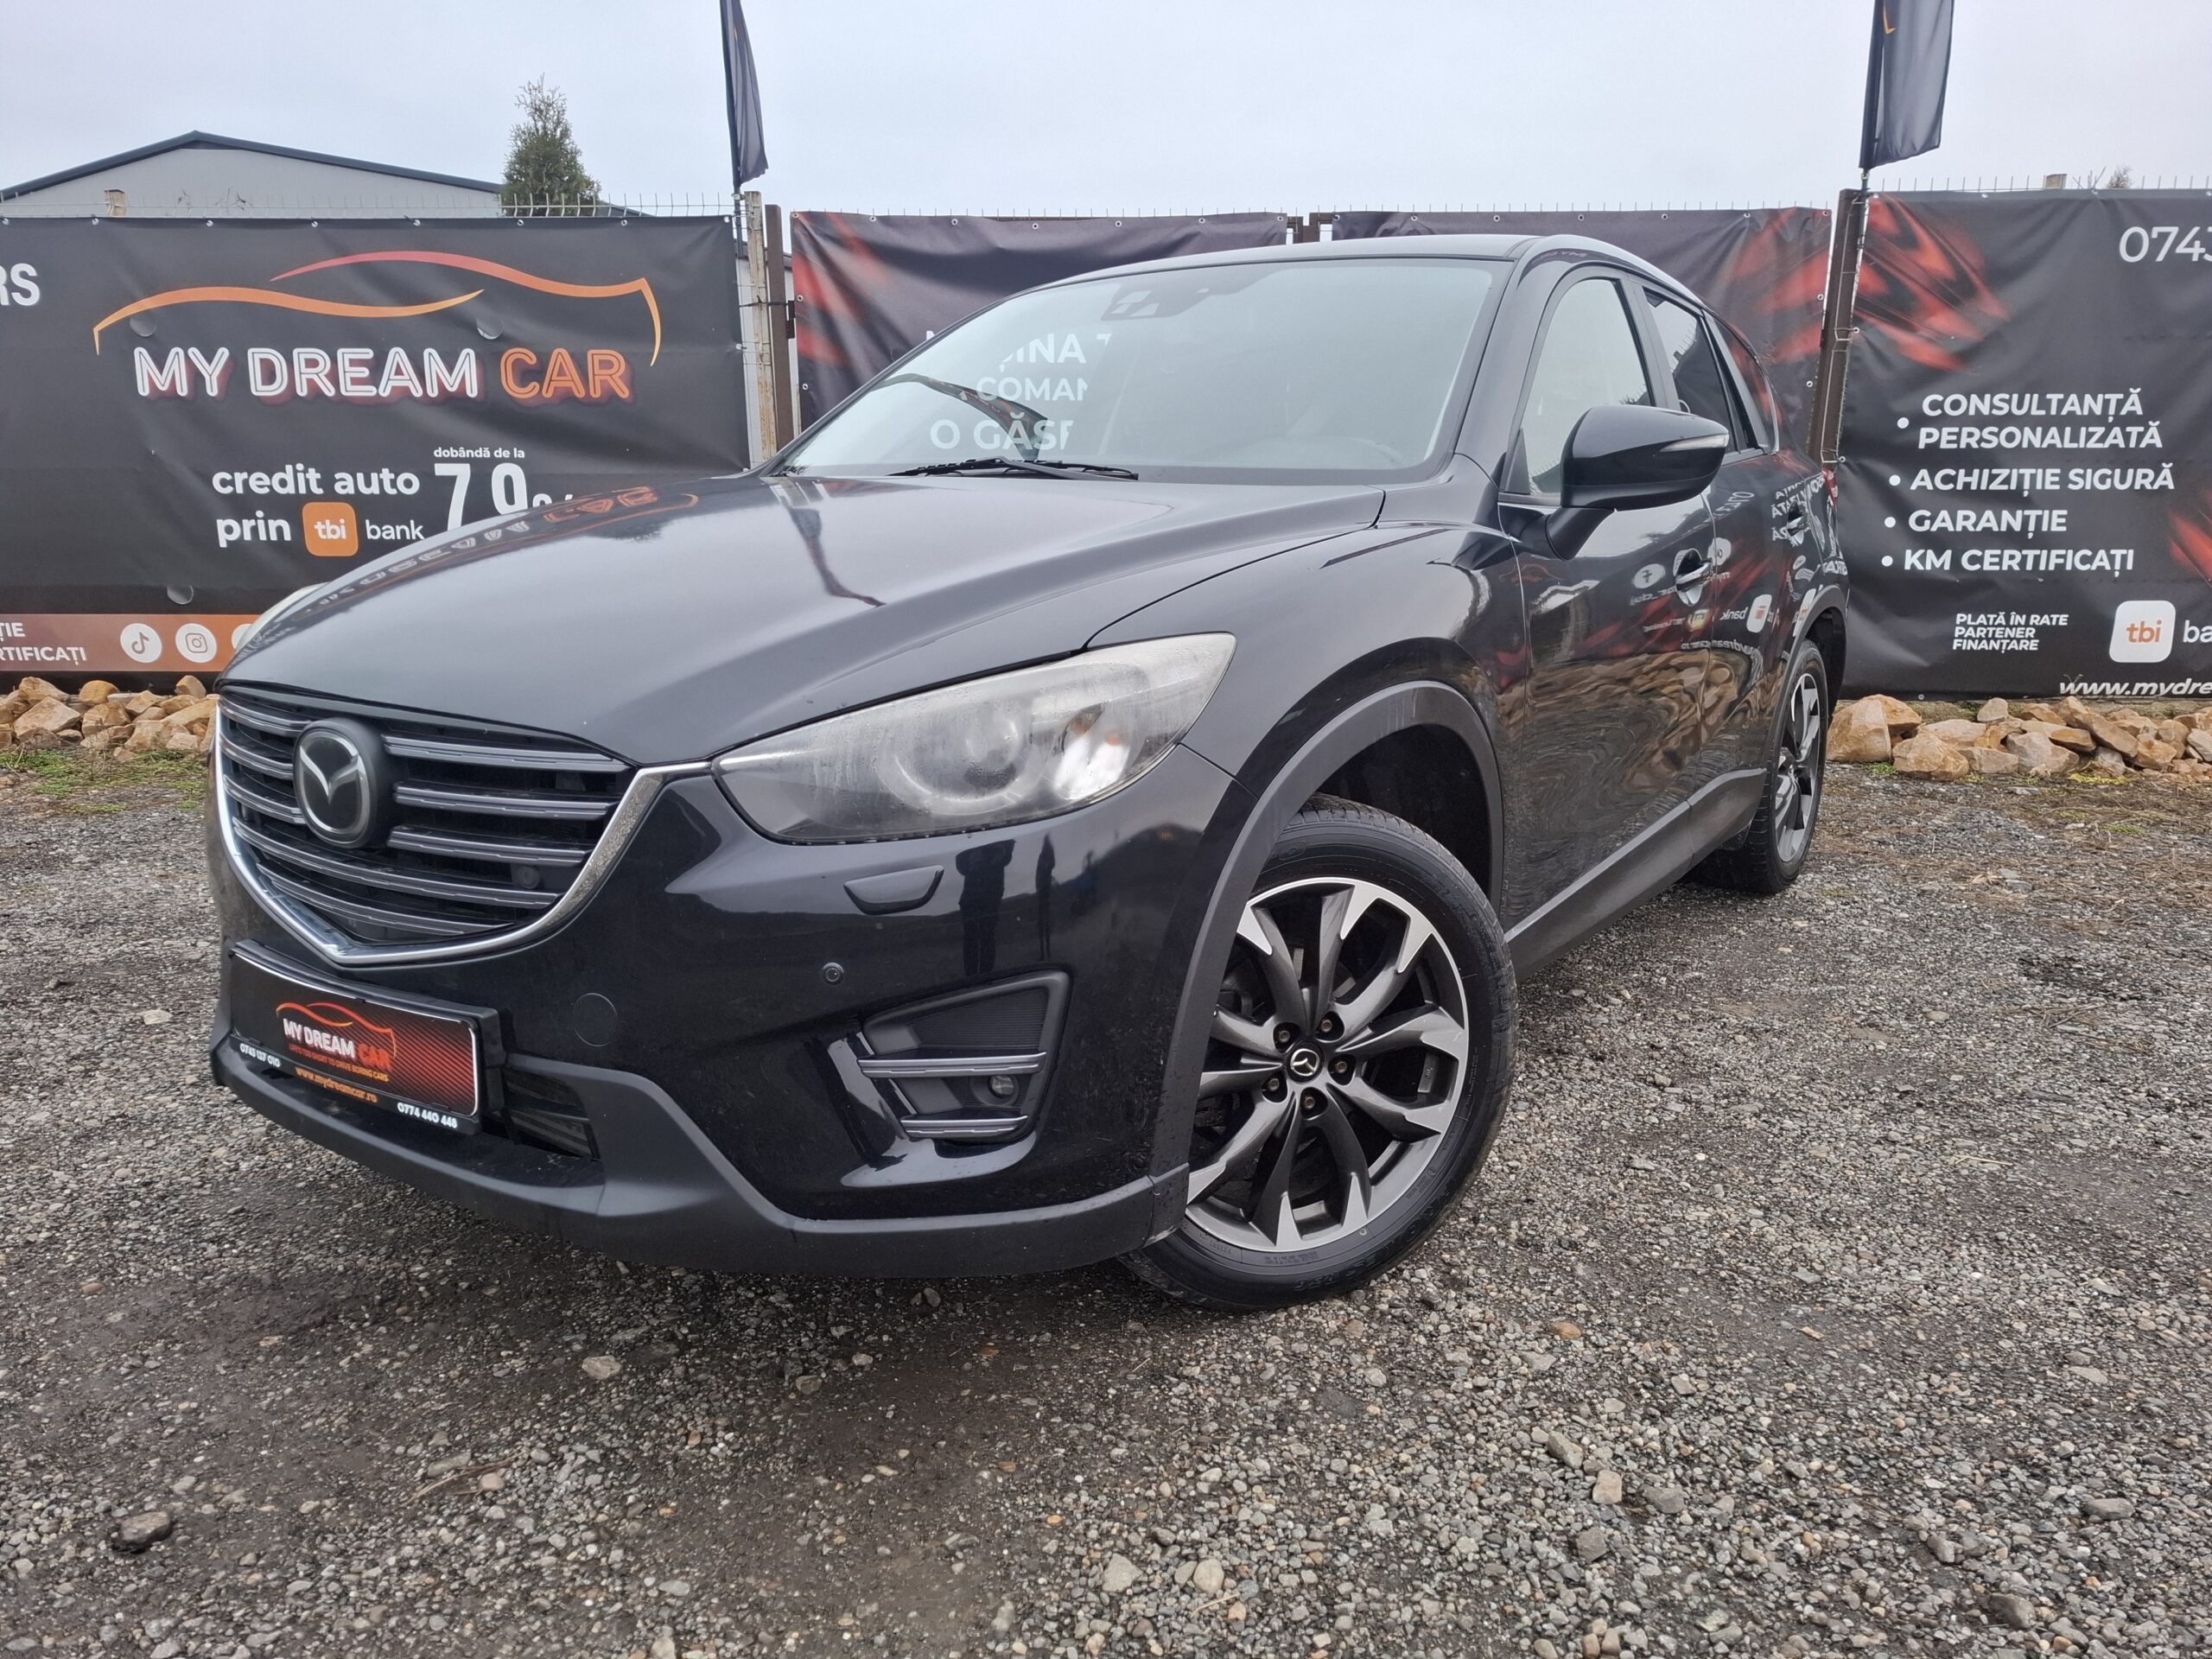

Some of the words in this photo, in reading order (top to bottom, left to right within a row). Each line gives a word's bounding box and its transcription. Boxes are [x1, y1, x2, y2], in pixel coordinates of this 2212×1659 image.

[134, 346, 230, 397] MY
[247, 346, 478, 398] DREAM
[500, 347, 630, 398] CAR
[1922, 387, 2143, 423] CONSULTANȚĂ
[930, 419, 961, 450] O
[1918, 421, 2163, 449] PERSONALIZATĂ
[434, 447, 491, 458] dobândă
[493, 448, 510, 458] de
[513, 448, 525, 458] la
[212, 463, 324, 495] credit
[334, 467, 420, 495] auto
[1910, 468, 2061, 497] ACHIZIȚIE
[2068, 462, 2175, 490] SIGURĂ
[216, 510, 291, 548] prin
[314, 518, 346, 539] tbi
[365, 519, 425, 540] bank
[1908, 510, 2068, 539] GARANȚIE
[1904, 550, 1952, 570] KM
[1961, 550, 2134, 577] CERTIFICAȚI
[1955, 612, 2006, 626] PLATĂ
[2010, 612, 2026, 626] ÎN
[2030, 614, 2069, 626] RATE
[1955, 626, 2036, 639] PARTENER
[2126, 620, 2162, 643] tbi
[0, 646, 86, 665] TIFICAȚI
[1952, 639, 2039, 653] FINANȚARE
[2059, 677, 2212, 696] www.mydre
[283, 1018, 302, 1040] MY
[303, 1026, 356, 1058] DREAM
[357, 1043, 391, 1070] CAR
